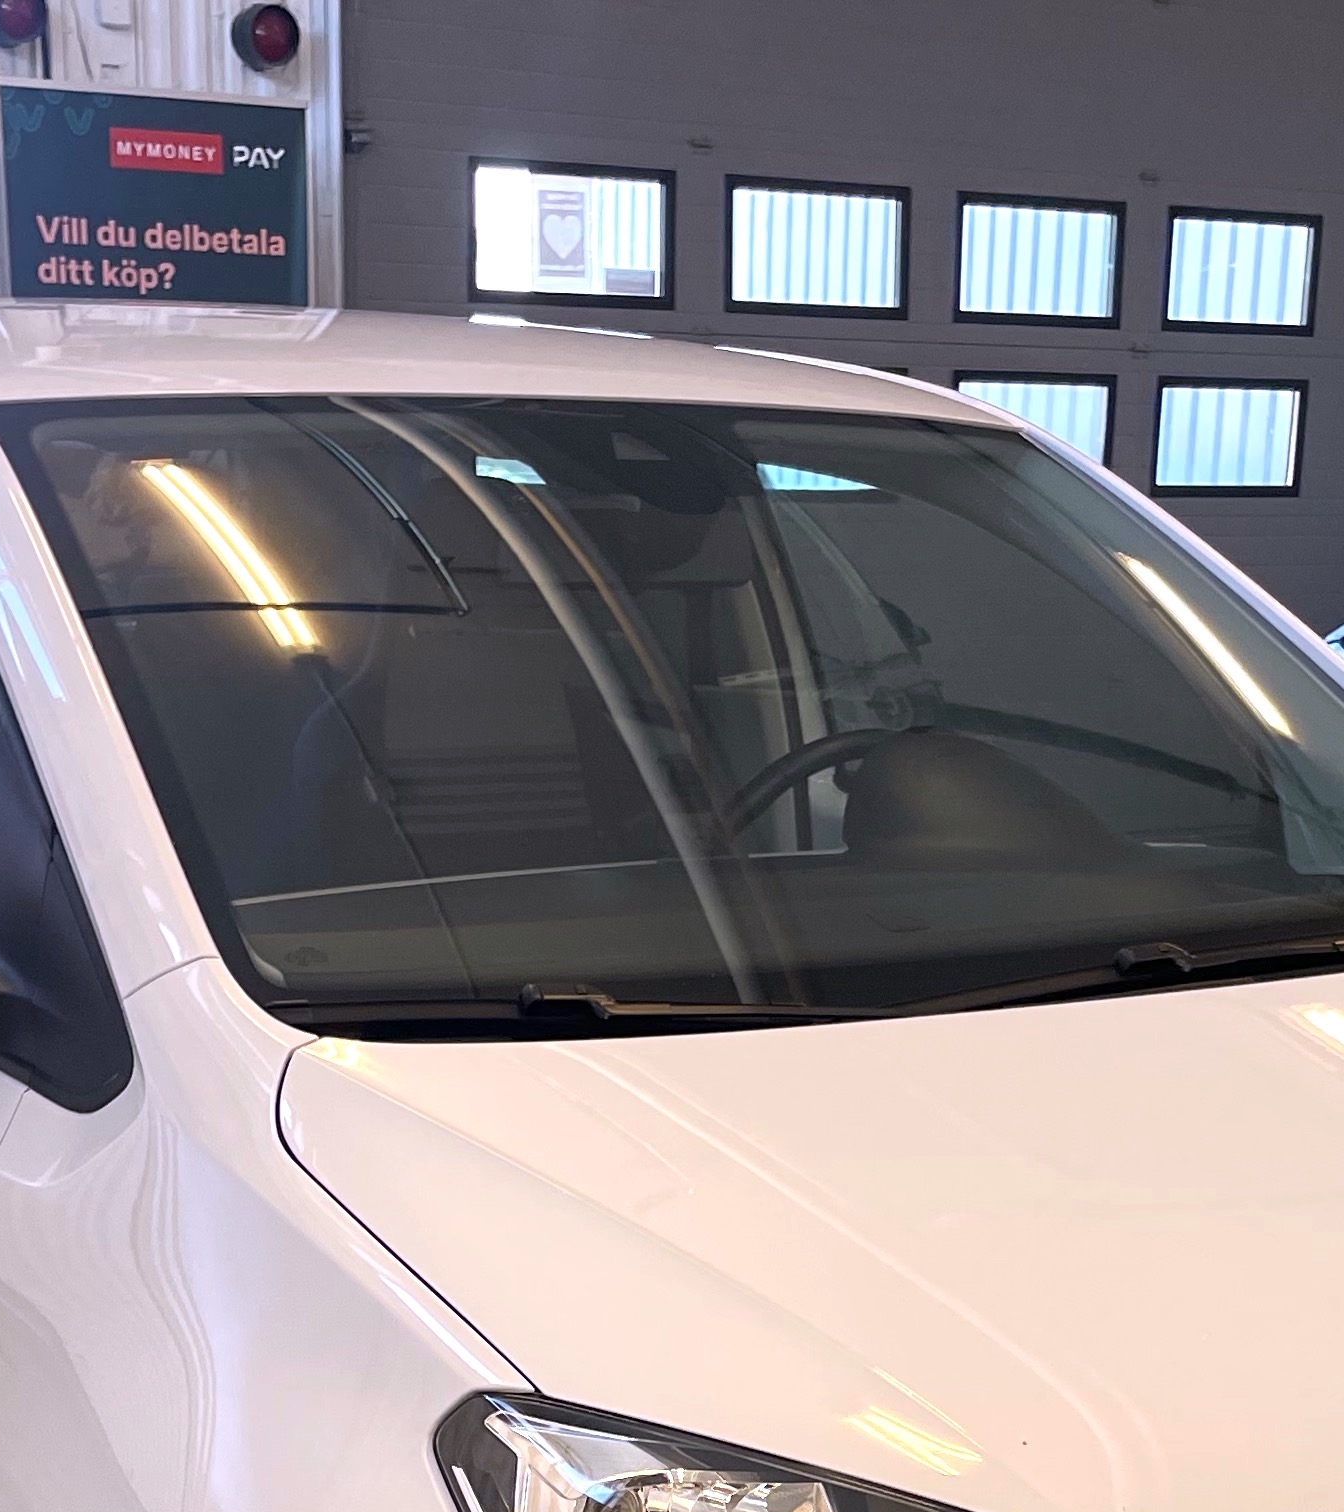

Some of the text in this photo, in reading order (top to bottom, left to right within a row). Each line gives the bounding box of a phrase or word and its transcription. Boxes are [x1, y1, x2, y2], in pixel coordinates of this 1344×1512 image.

[116, 141, 285, 170] MYMONEY PAY
[36, 215, 286, 257] Vill du delbetala
[37, 256, 176, 295] ditt köp?
